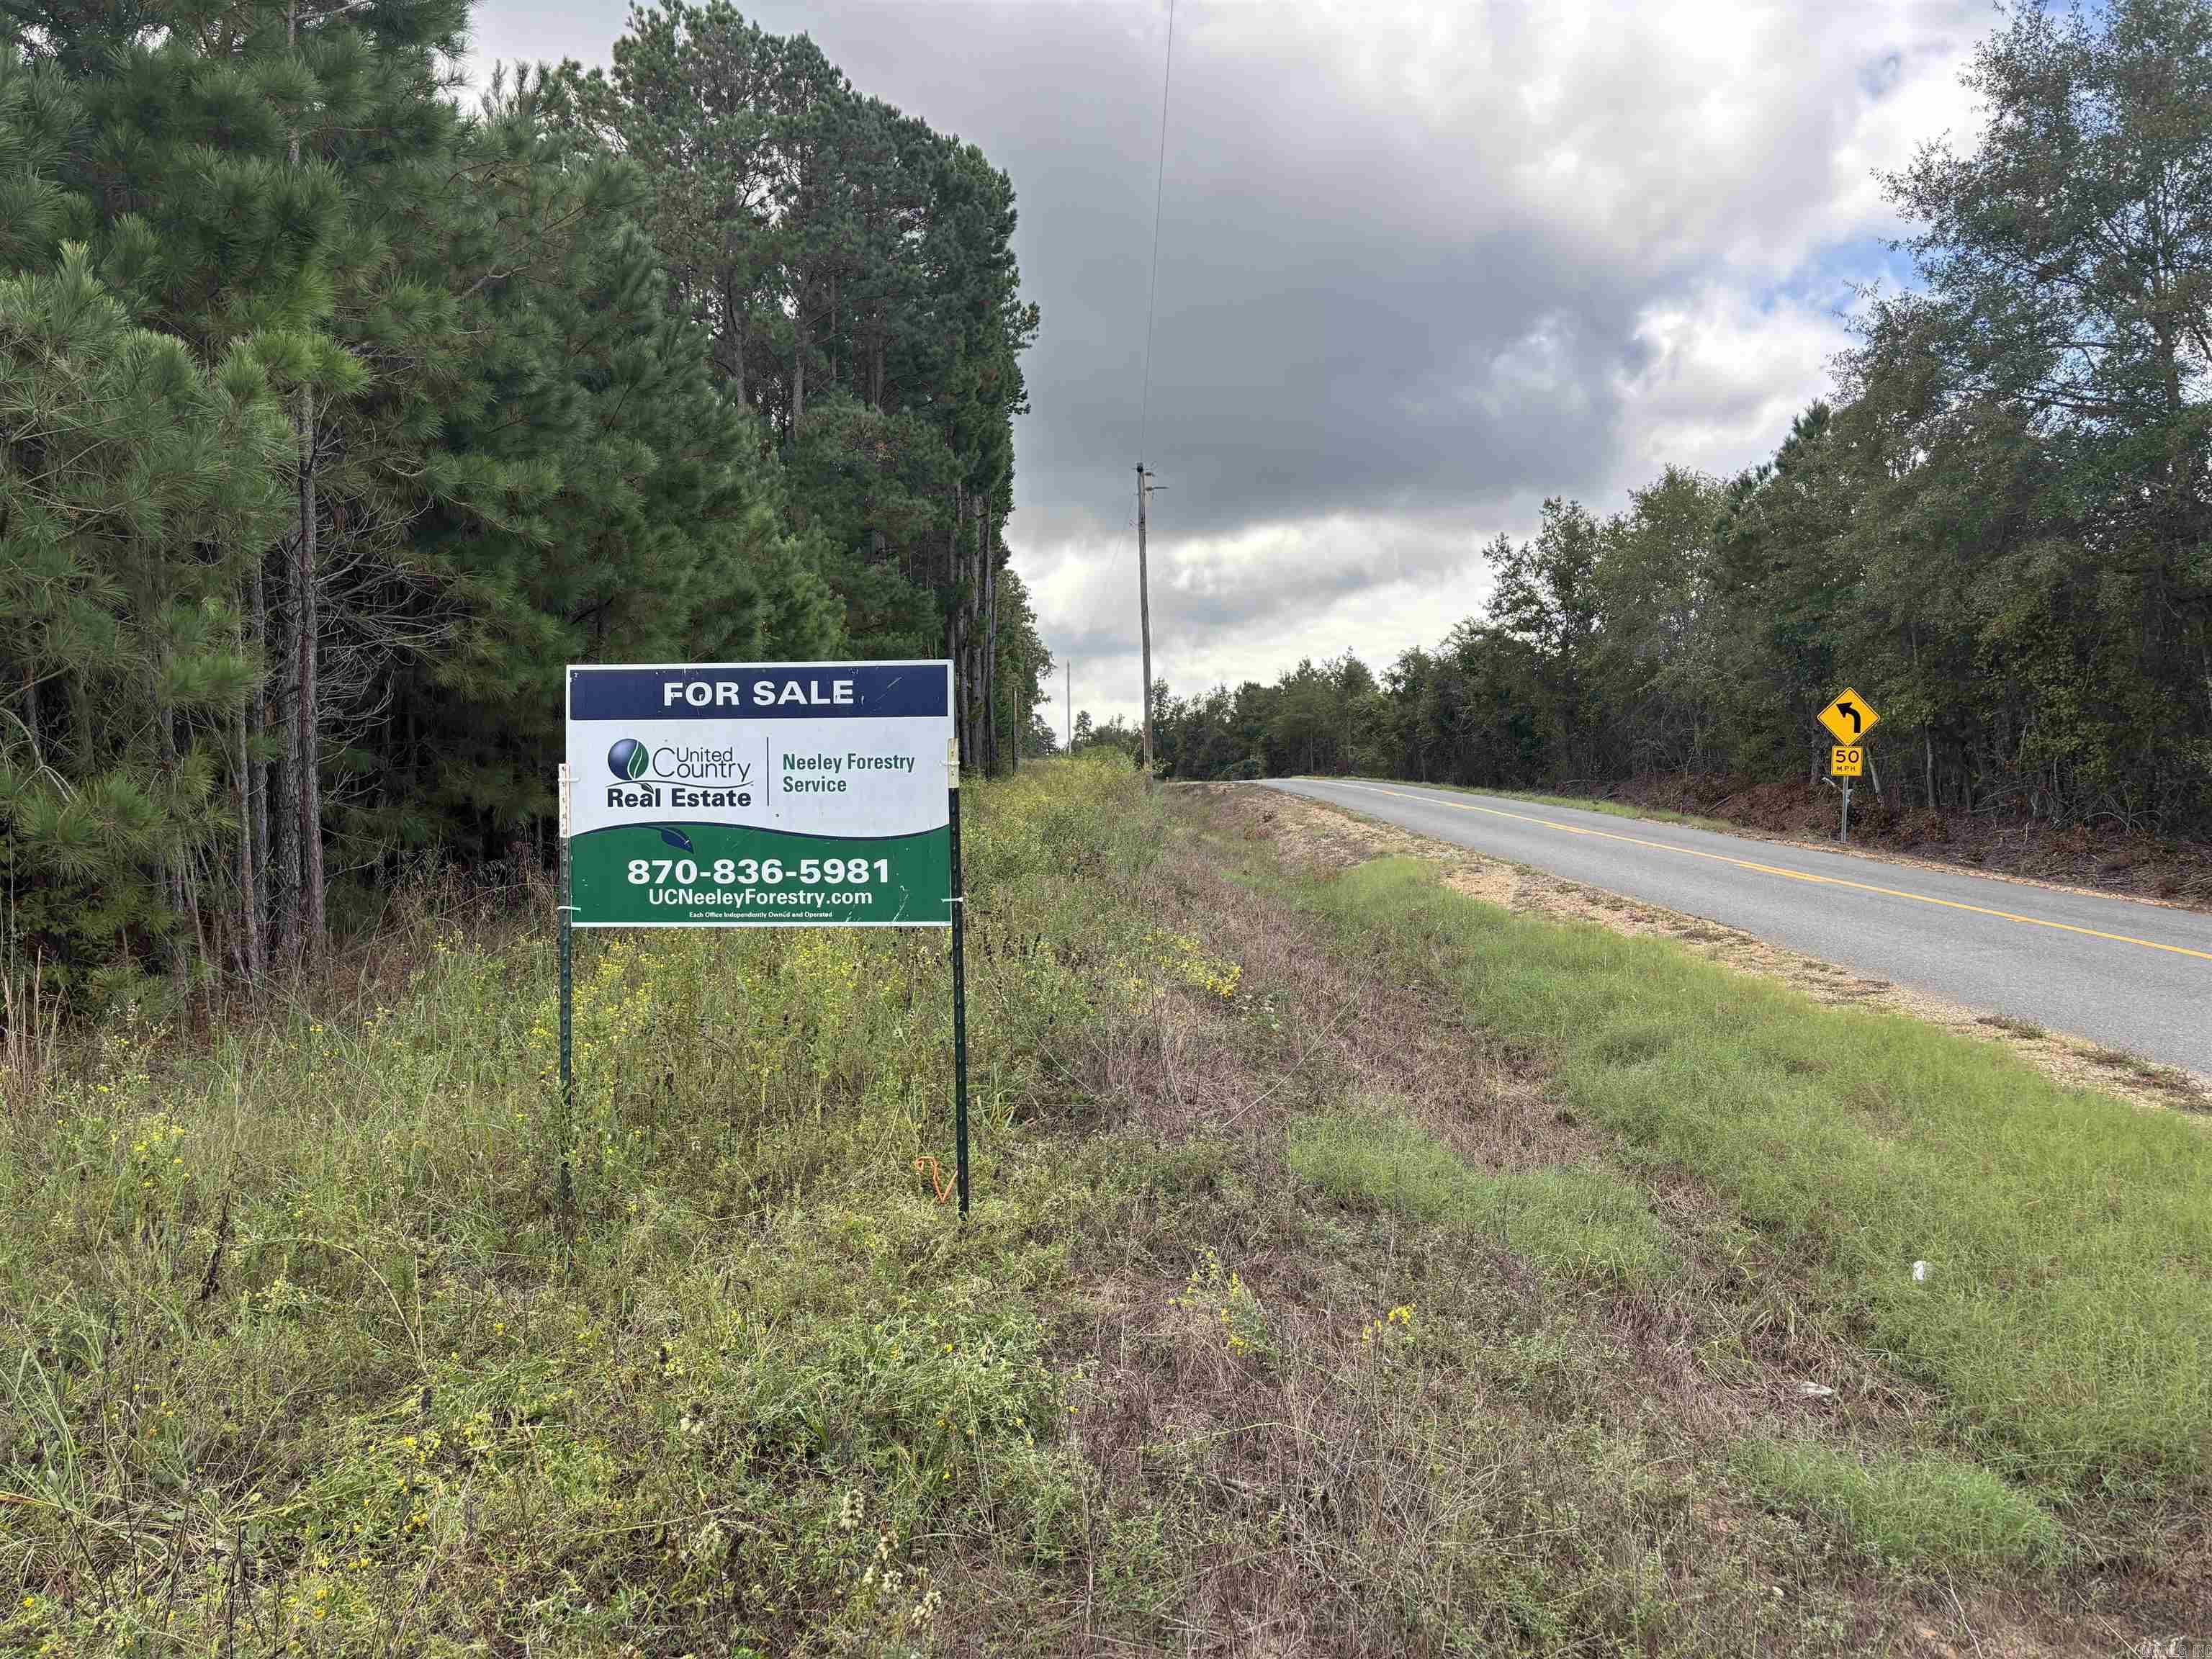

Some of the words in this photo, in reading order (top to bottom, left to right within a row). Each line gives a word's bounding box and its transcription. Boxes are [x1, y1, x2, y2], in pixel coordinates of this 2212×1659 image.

[663, 681, 739, 706] FOR
[752, 680, 855, 706] SALE
[652, 747, 751, 783] Country
[676, 746, 733, 763] United
[782, 752, 842, 773] Neeley
[847, 752, 915, 773] Forestry
[1835, 750, 1860, 763] 50
[782, 775, 848, 793] Service
[606, 788, 661, 807] Real
[671, 788, 752, 807] Estate
[627, 858, 889, 885] 870-836-5981
[648, 887, 873, 909] UCNeeleyForestry.com
